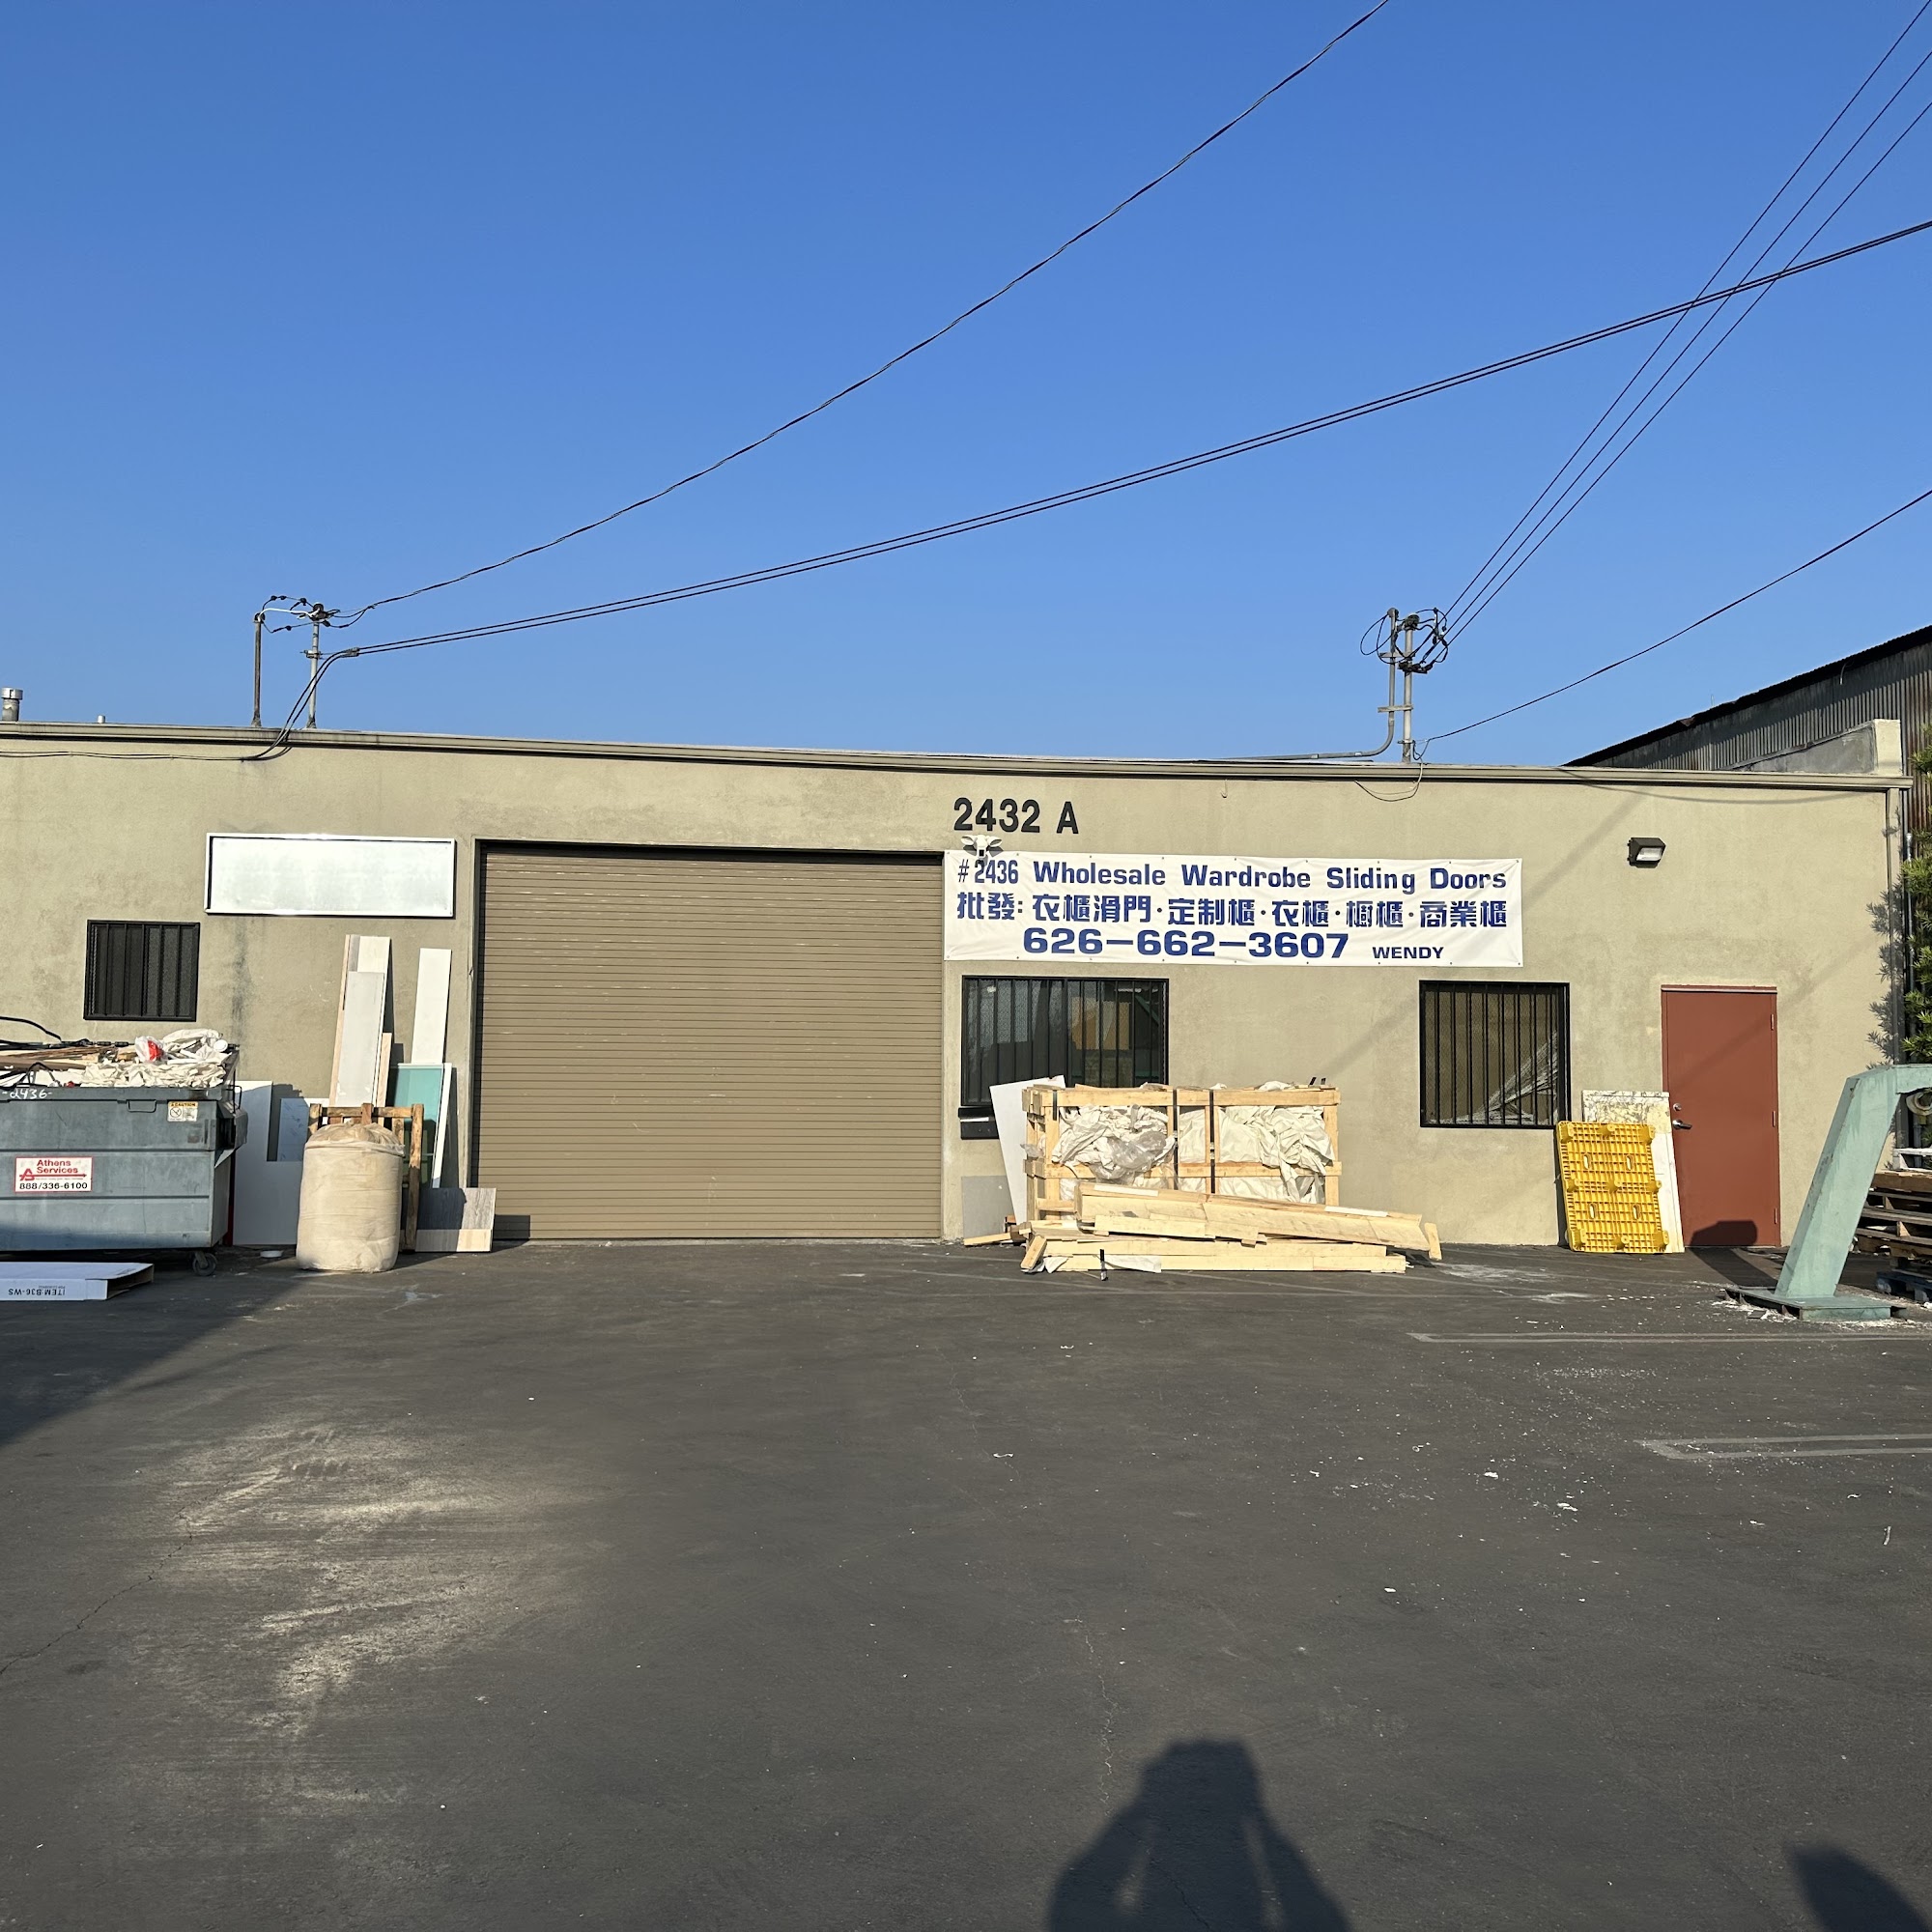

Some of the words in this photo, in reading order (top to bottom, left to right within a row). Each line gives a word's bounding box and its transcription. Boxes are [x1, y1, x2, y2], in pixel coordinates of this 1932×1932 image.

[953, 797, 1040, 833] 2432
[1056, 801, 1079, 835] A
[1033, 861, 1166, 886] Wholesale
[1181, 864, 1311, 888] Wardrobe
[1326, 867, 1415, 895] Sliding
[1430, 867, 1507, 889] Doors
[1023, 927, 1349, 959] 626-662-3607
[1372, 946, 1444, 959] WENDY
